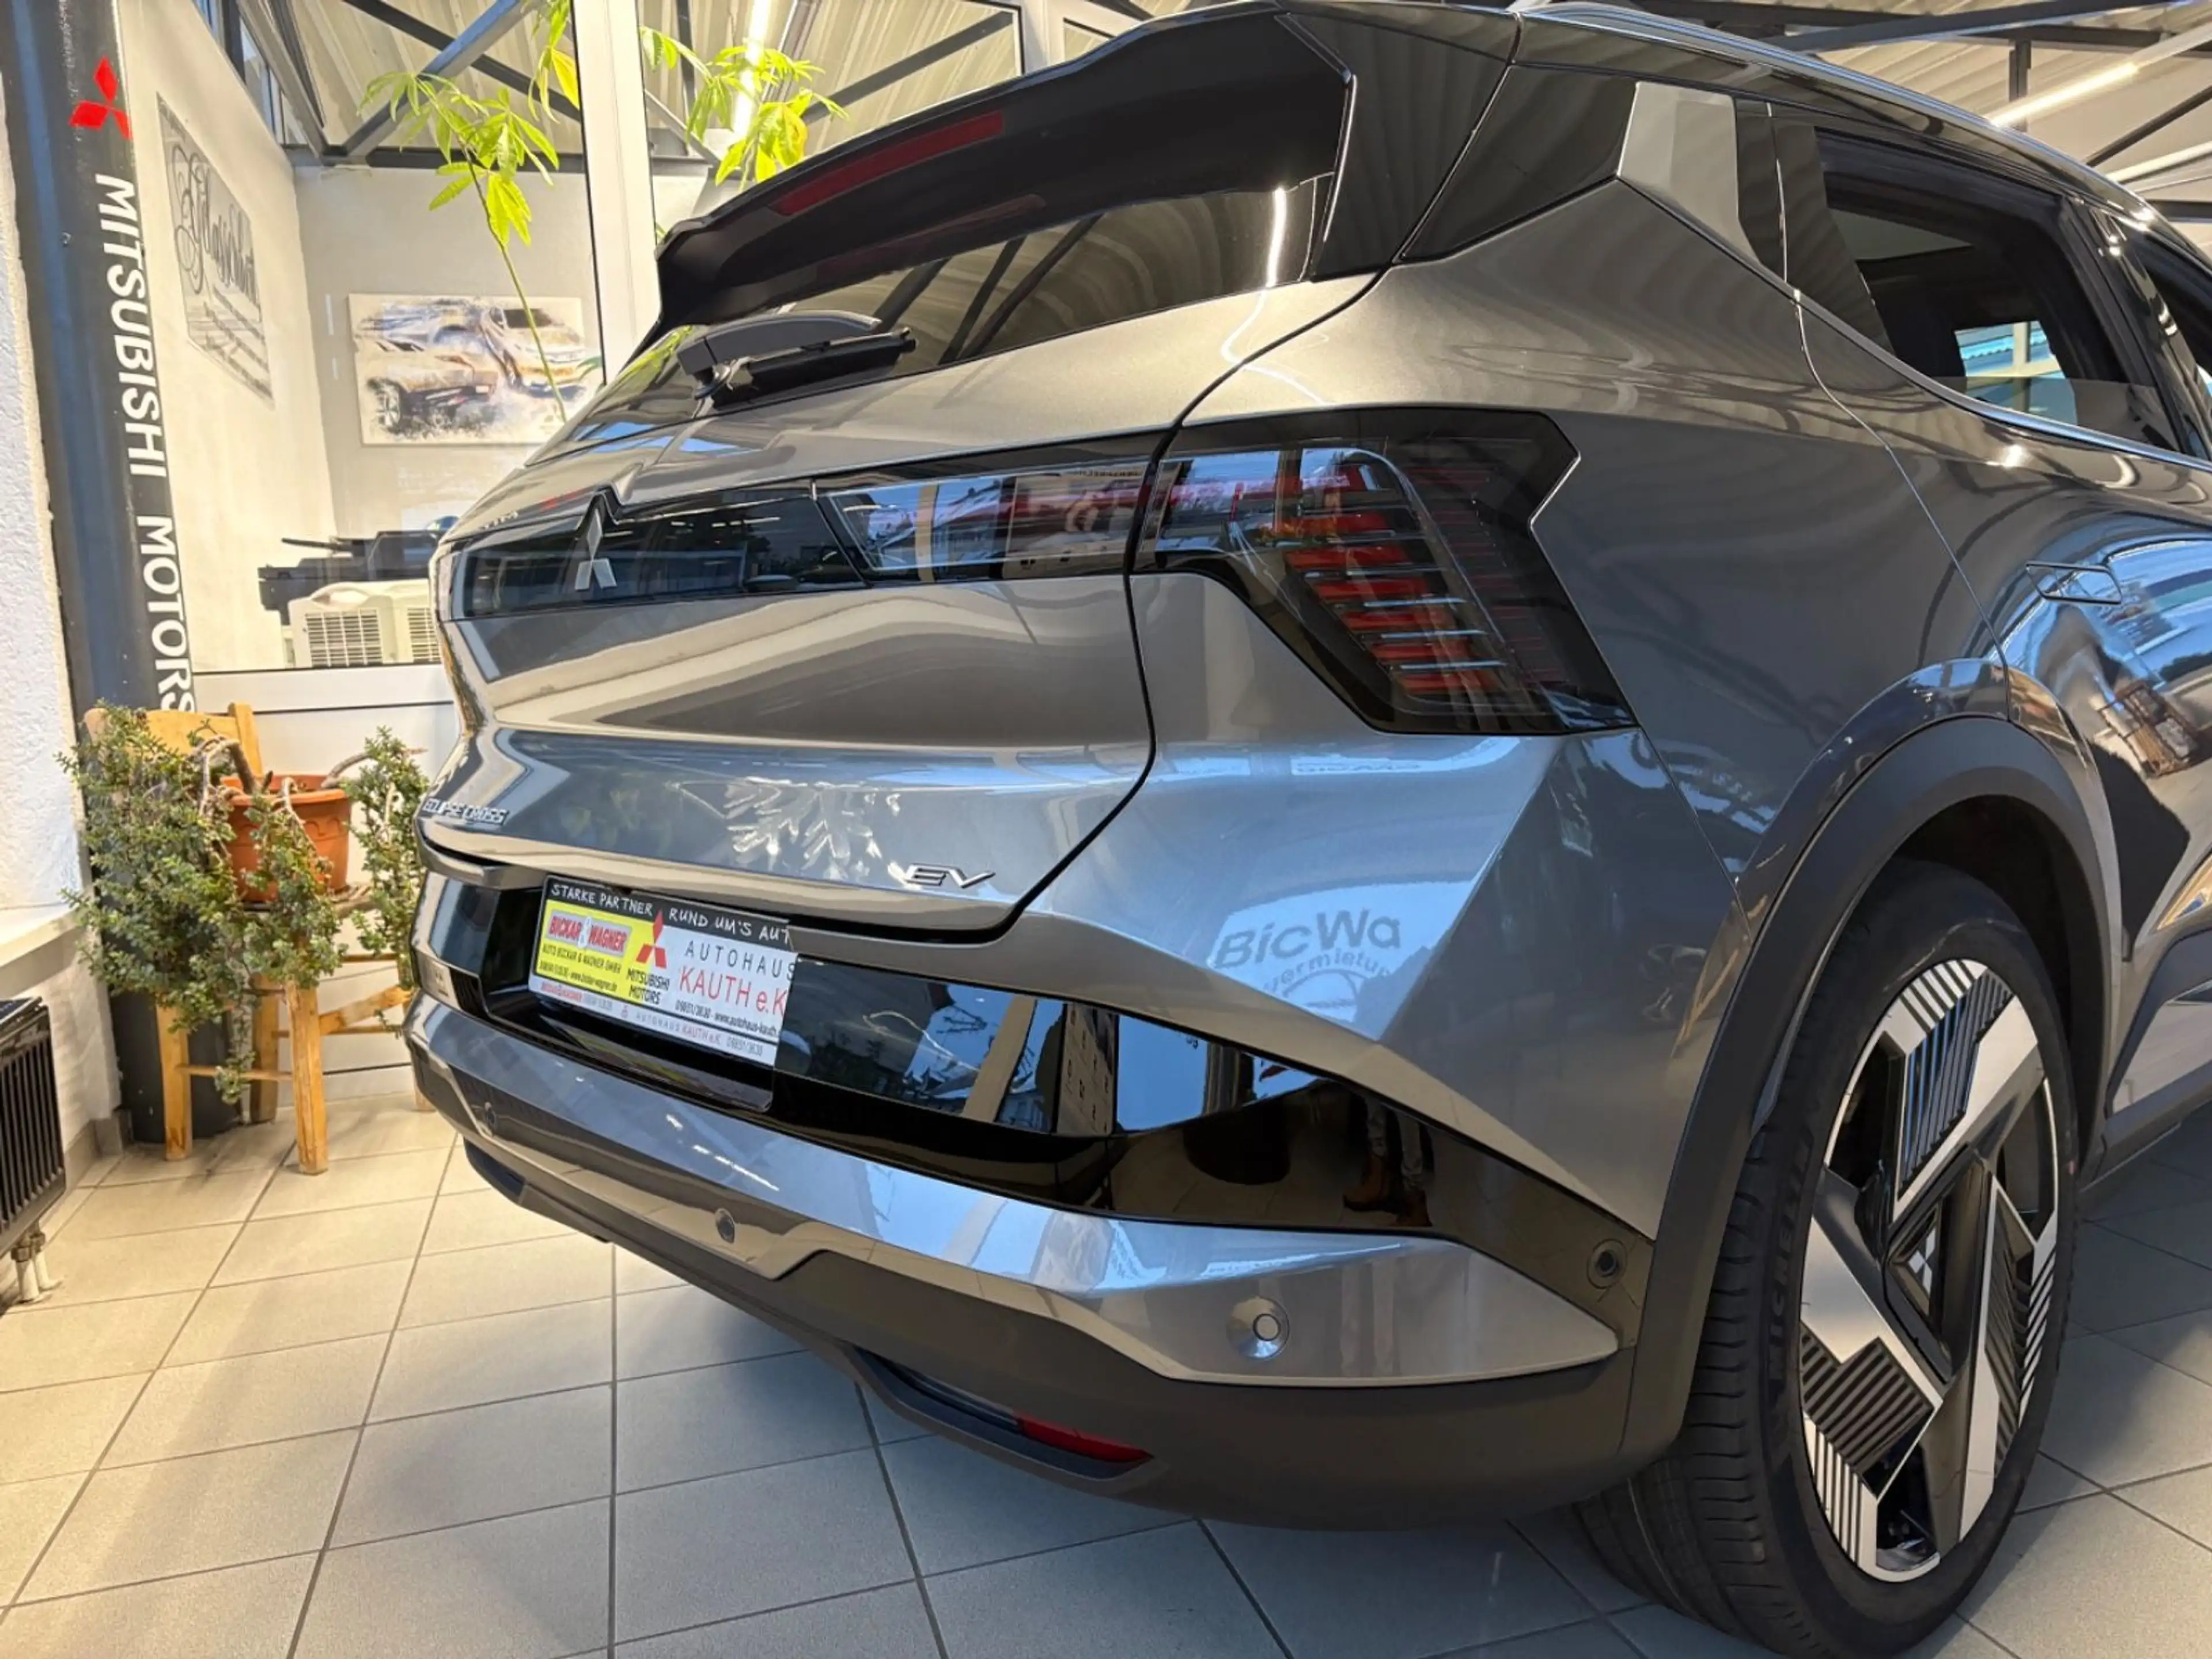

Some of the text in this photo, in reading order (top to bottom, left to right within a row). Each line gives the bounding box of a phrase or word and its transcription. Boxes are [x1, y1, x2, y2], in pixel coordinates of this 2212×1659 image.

[95, 173, 195, 712] MITSUBISHI MOTORS
[904, 863, 995, 888] EV
[551, 884, 596, 904] STARKE
[599, 894, 653, 916] PARTNER
[668, 907, 709, 927] RUND
[1213, 908, 1402, 969] BicWa
[627, 967, 671, 991] MITSUBISHI
[685, 940, 796, 980] AUTOHAUS
[629, 984, 661, 1005] MOTORS
[679, 965, 752, 1008] KAUTH
